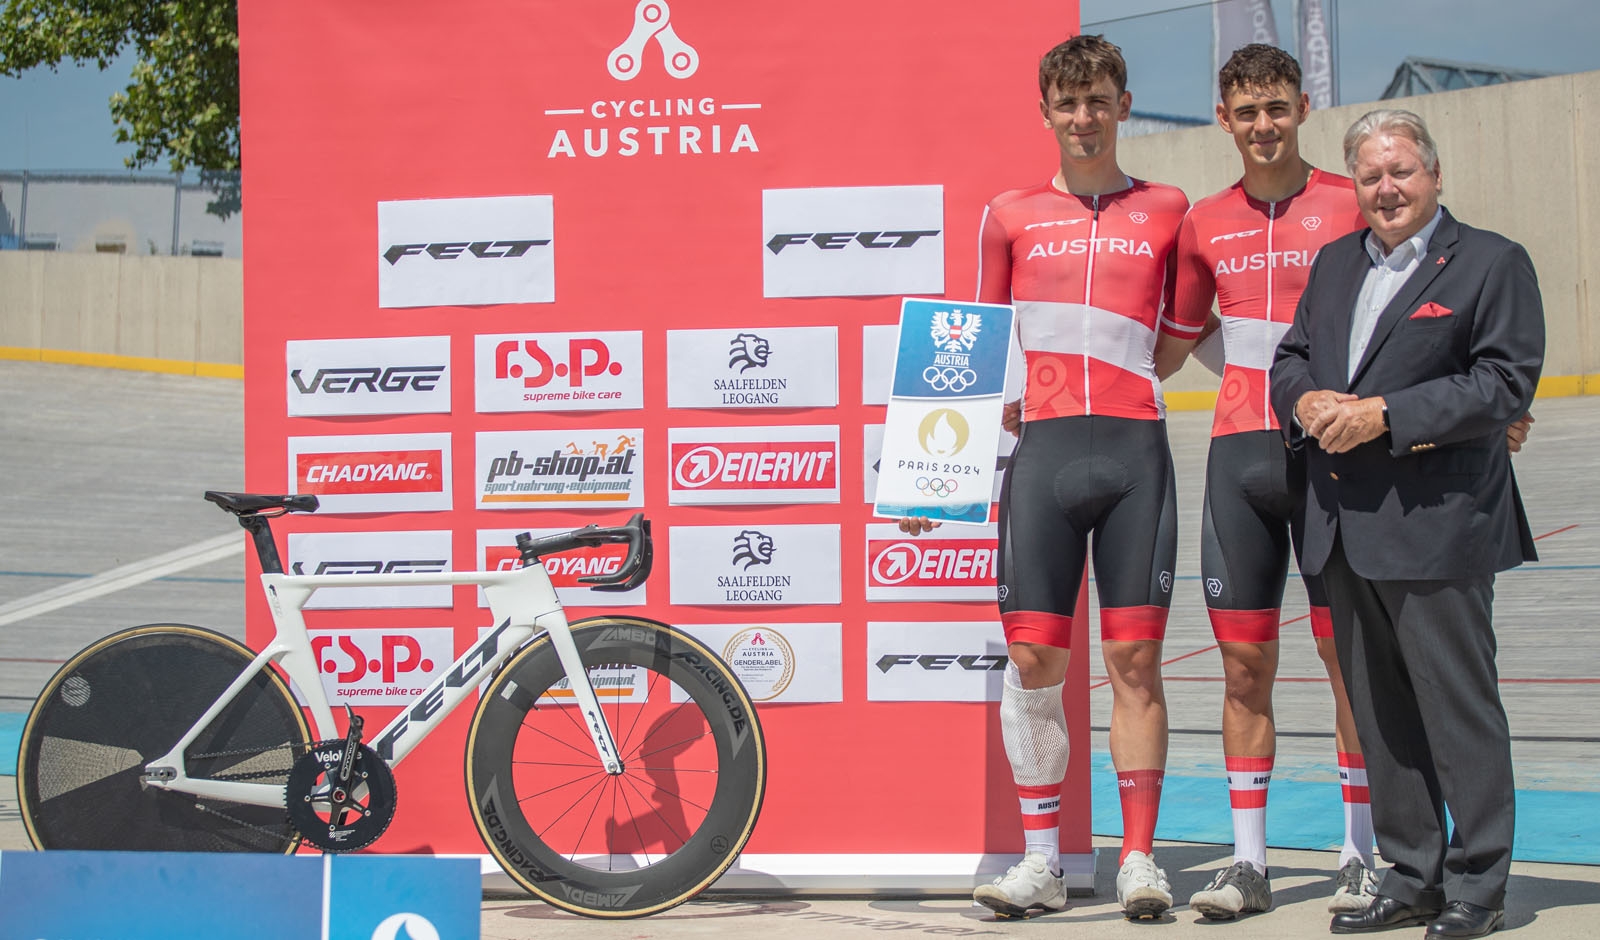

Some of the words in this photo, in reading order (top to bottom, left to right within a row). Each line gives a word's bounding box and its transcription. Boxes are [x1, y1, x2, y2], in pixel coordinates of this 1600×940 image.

[590, 97, 716, 119] CYCLING
[547, 123, 760, 158] AUSTRIA
[382, 239, 552, 266] FELT
[766, 229, 941, 256] FELT
[1026, 237, 1154, 261] AUSTRIA
[934, 354, 969, 367] AUSTRIA
[290, 365, 446, 394] VERGE
[714, 378, 787, 390] SAALFELDEN
[523, 392, 571, 402] supreme
[572, 390, 596, 400] bike
[597, 391, 622, 399] care
[722, 393, 779, 404] LEOGANG
[306, 462, 429, 483] CHAOYANG
[487, 448, 636, 483] pb-shop.at
[720, 451, 833, 482] ENERVIT
[898, 460, 938, 472] PARIS
[943, 463, 980, 476] 2024
[497, 556, 622, 575] CHOYANG
[717, 575, 791, 587] SAALFELDEN
[725, 589, 783, 602] LEOGANG
[875, 654, 1008, 674] FELT
[336, 687, 383, 698] supreme
[385, 686, 408, 696] bike
[377, 616, 511, 761] FELT
